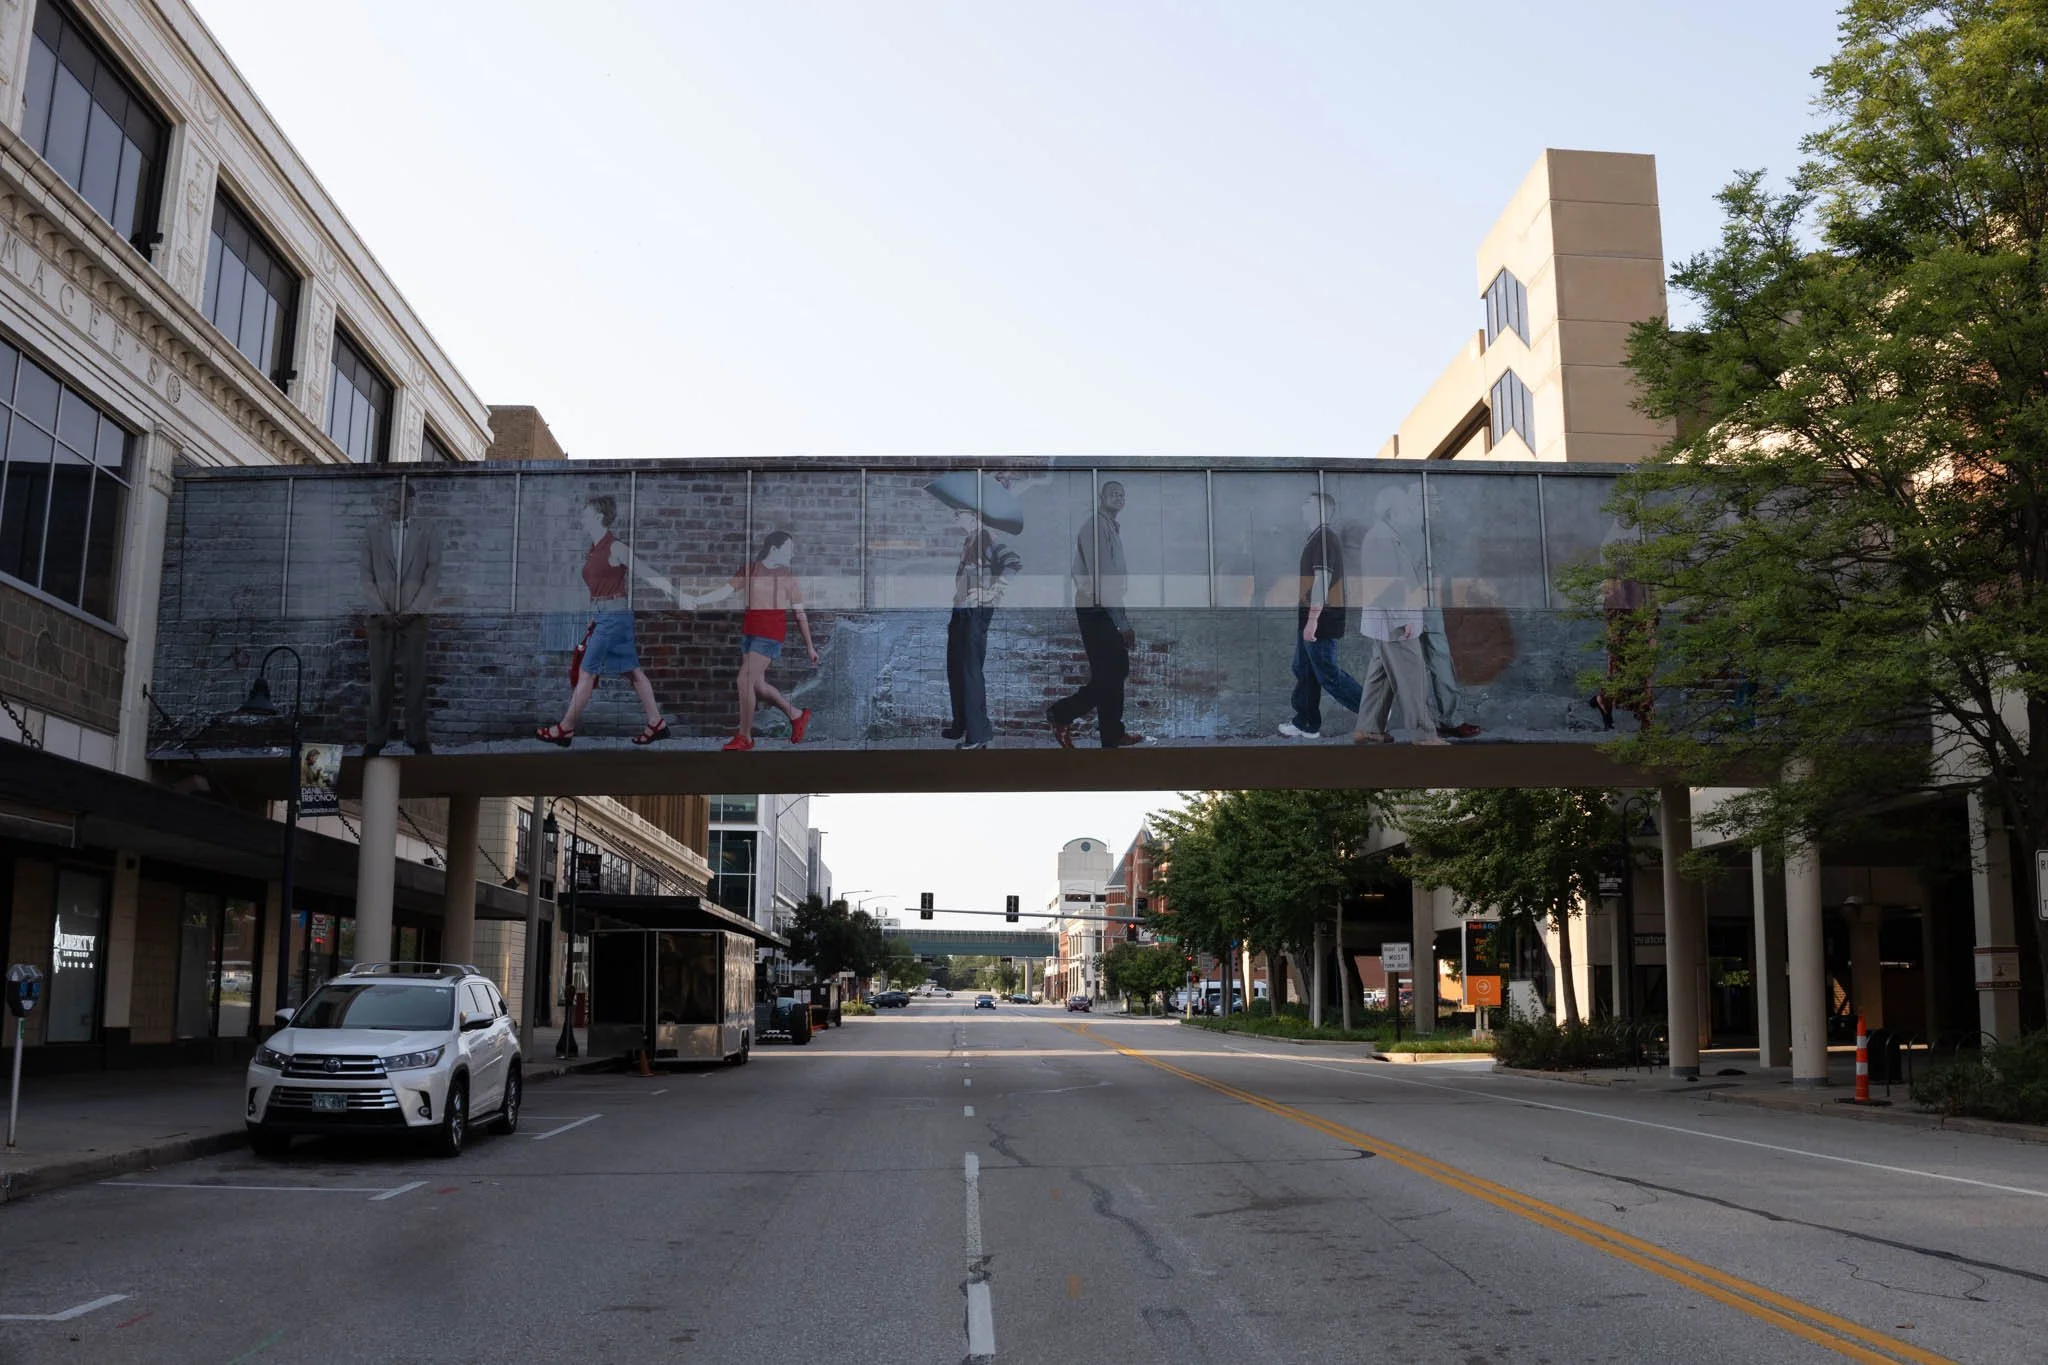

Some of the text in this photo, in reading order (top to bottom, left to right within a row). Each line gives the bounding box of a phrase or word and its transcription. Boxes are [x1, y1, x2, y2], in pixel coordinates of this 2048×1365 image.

[0, 231, 158, 385] MAGEE'S
[301, 794, 337, 802] TRIFONOV
[60, 933, 96, 951] LIBERTY
